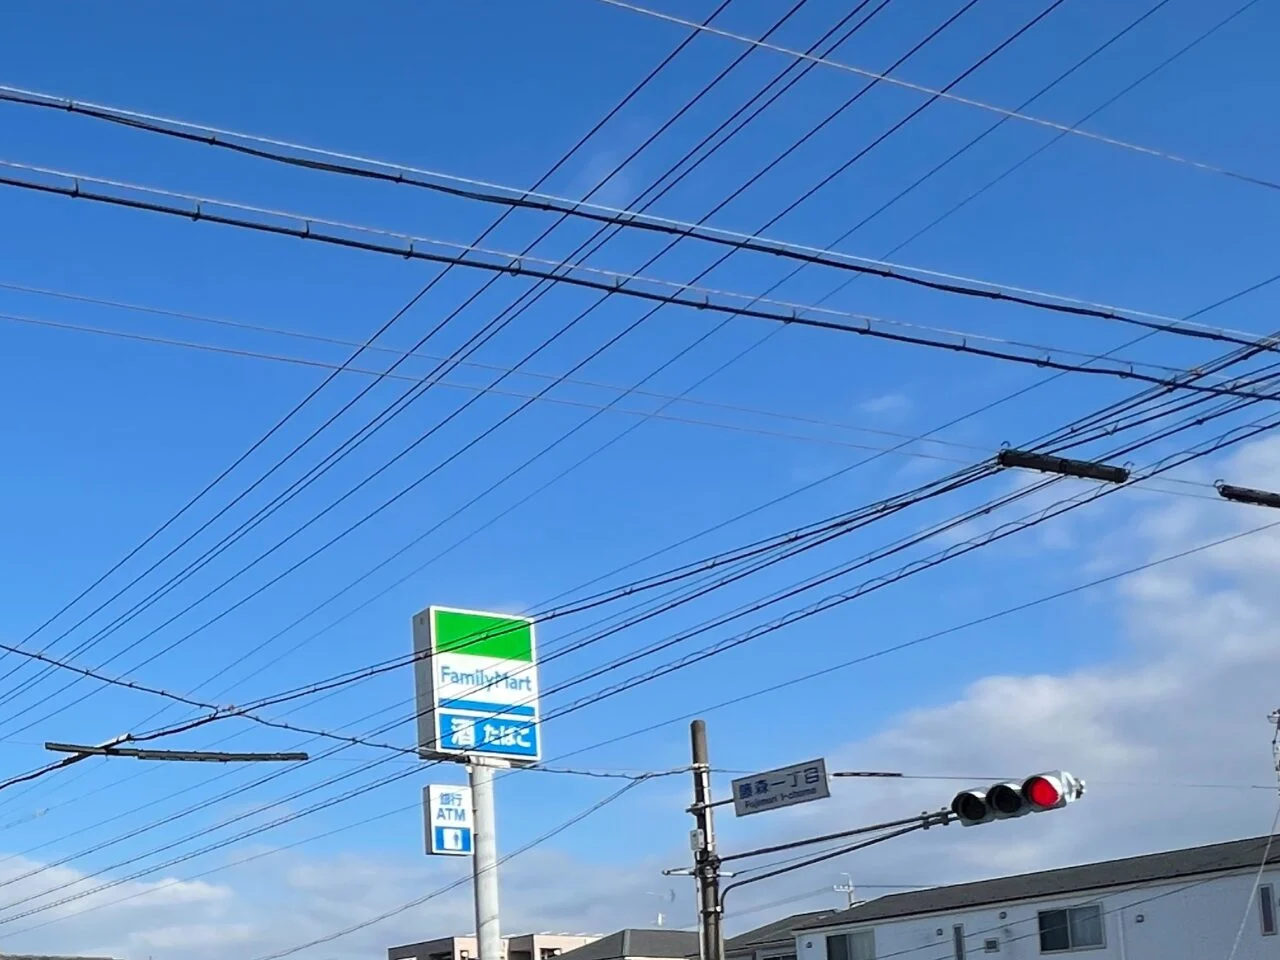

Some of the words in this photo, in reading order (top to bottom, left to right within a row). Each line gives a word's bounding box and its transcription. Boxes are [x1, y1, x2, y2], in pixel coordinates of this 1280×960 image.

[440, 665, 533, 693] FamilyMart
[450, 718, 476, 747] 酒
[483, 723, 531, 748] たばこ
[436, 807, 466, 822] ATM
